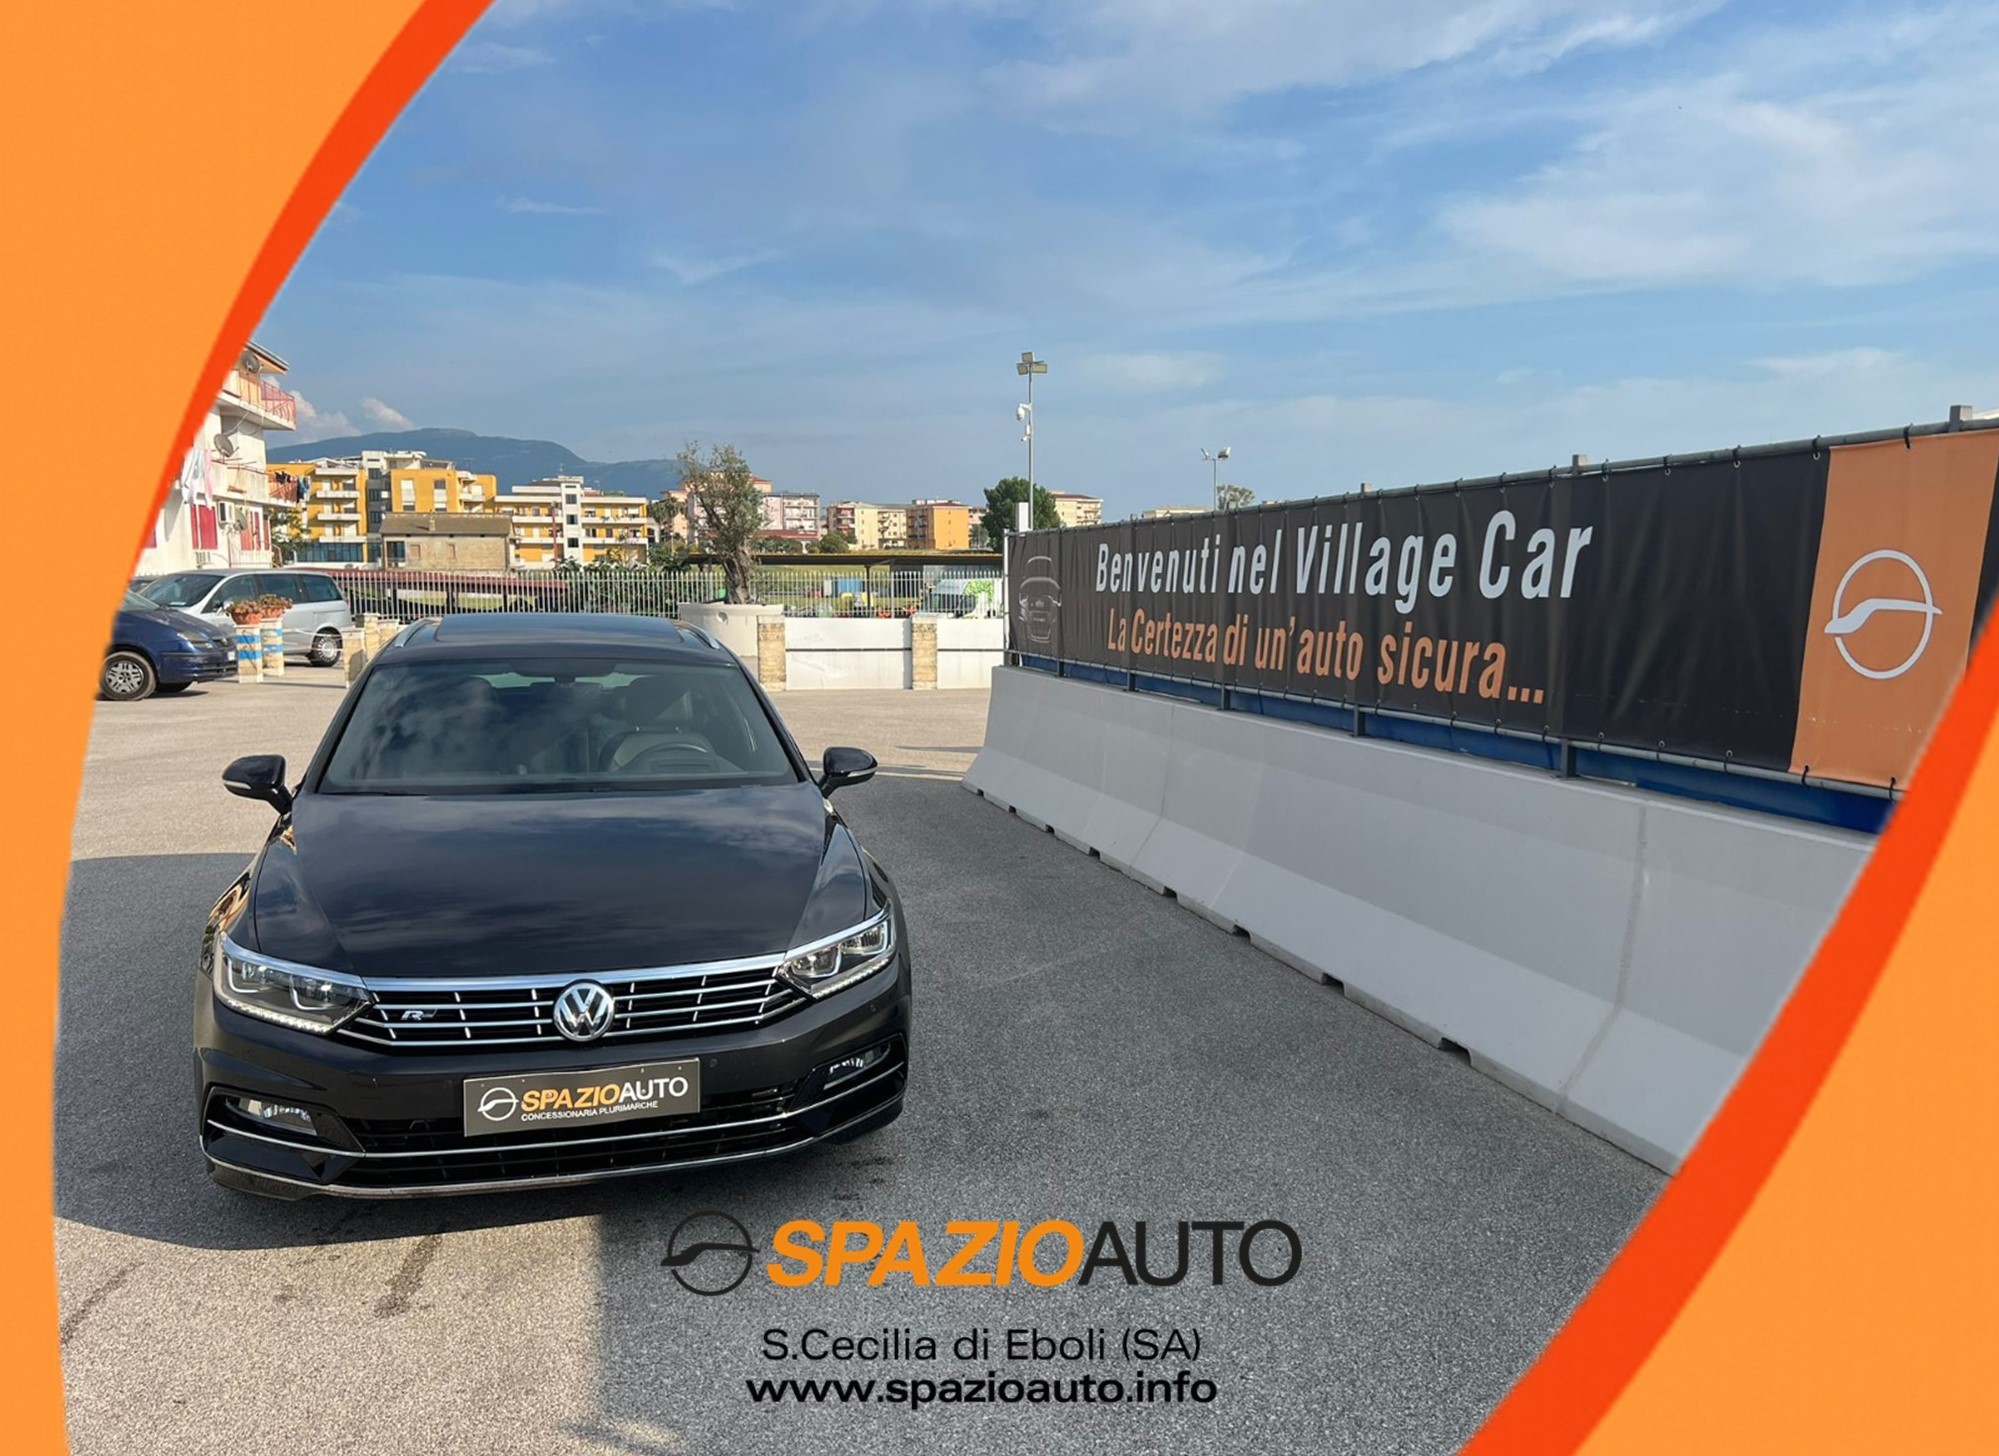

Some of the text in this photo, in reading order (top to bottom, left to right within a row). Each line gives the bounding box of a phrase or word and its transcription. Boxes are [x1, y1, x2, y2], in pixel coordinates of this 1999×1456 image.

[1096, 510, 1593, 614] Benvenuti nel Village Car
[1107, 608, 1128, 652] La
[1131, 608, 1218, 663] Certezza
[1224, 614, 1249, 666] di
[1378, 622, 1544, 703] sicura...
[521, 1077, 689, 1112] SPAZIOAUTO
[521, 1100, 659, 1122] CONCESSIONARIA PLURIMARCHE
